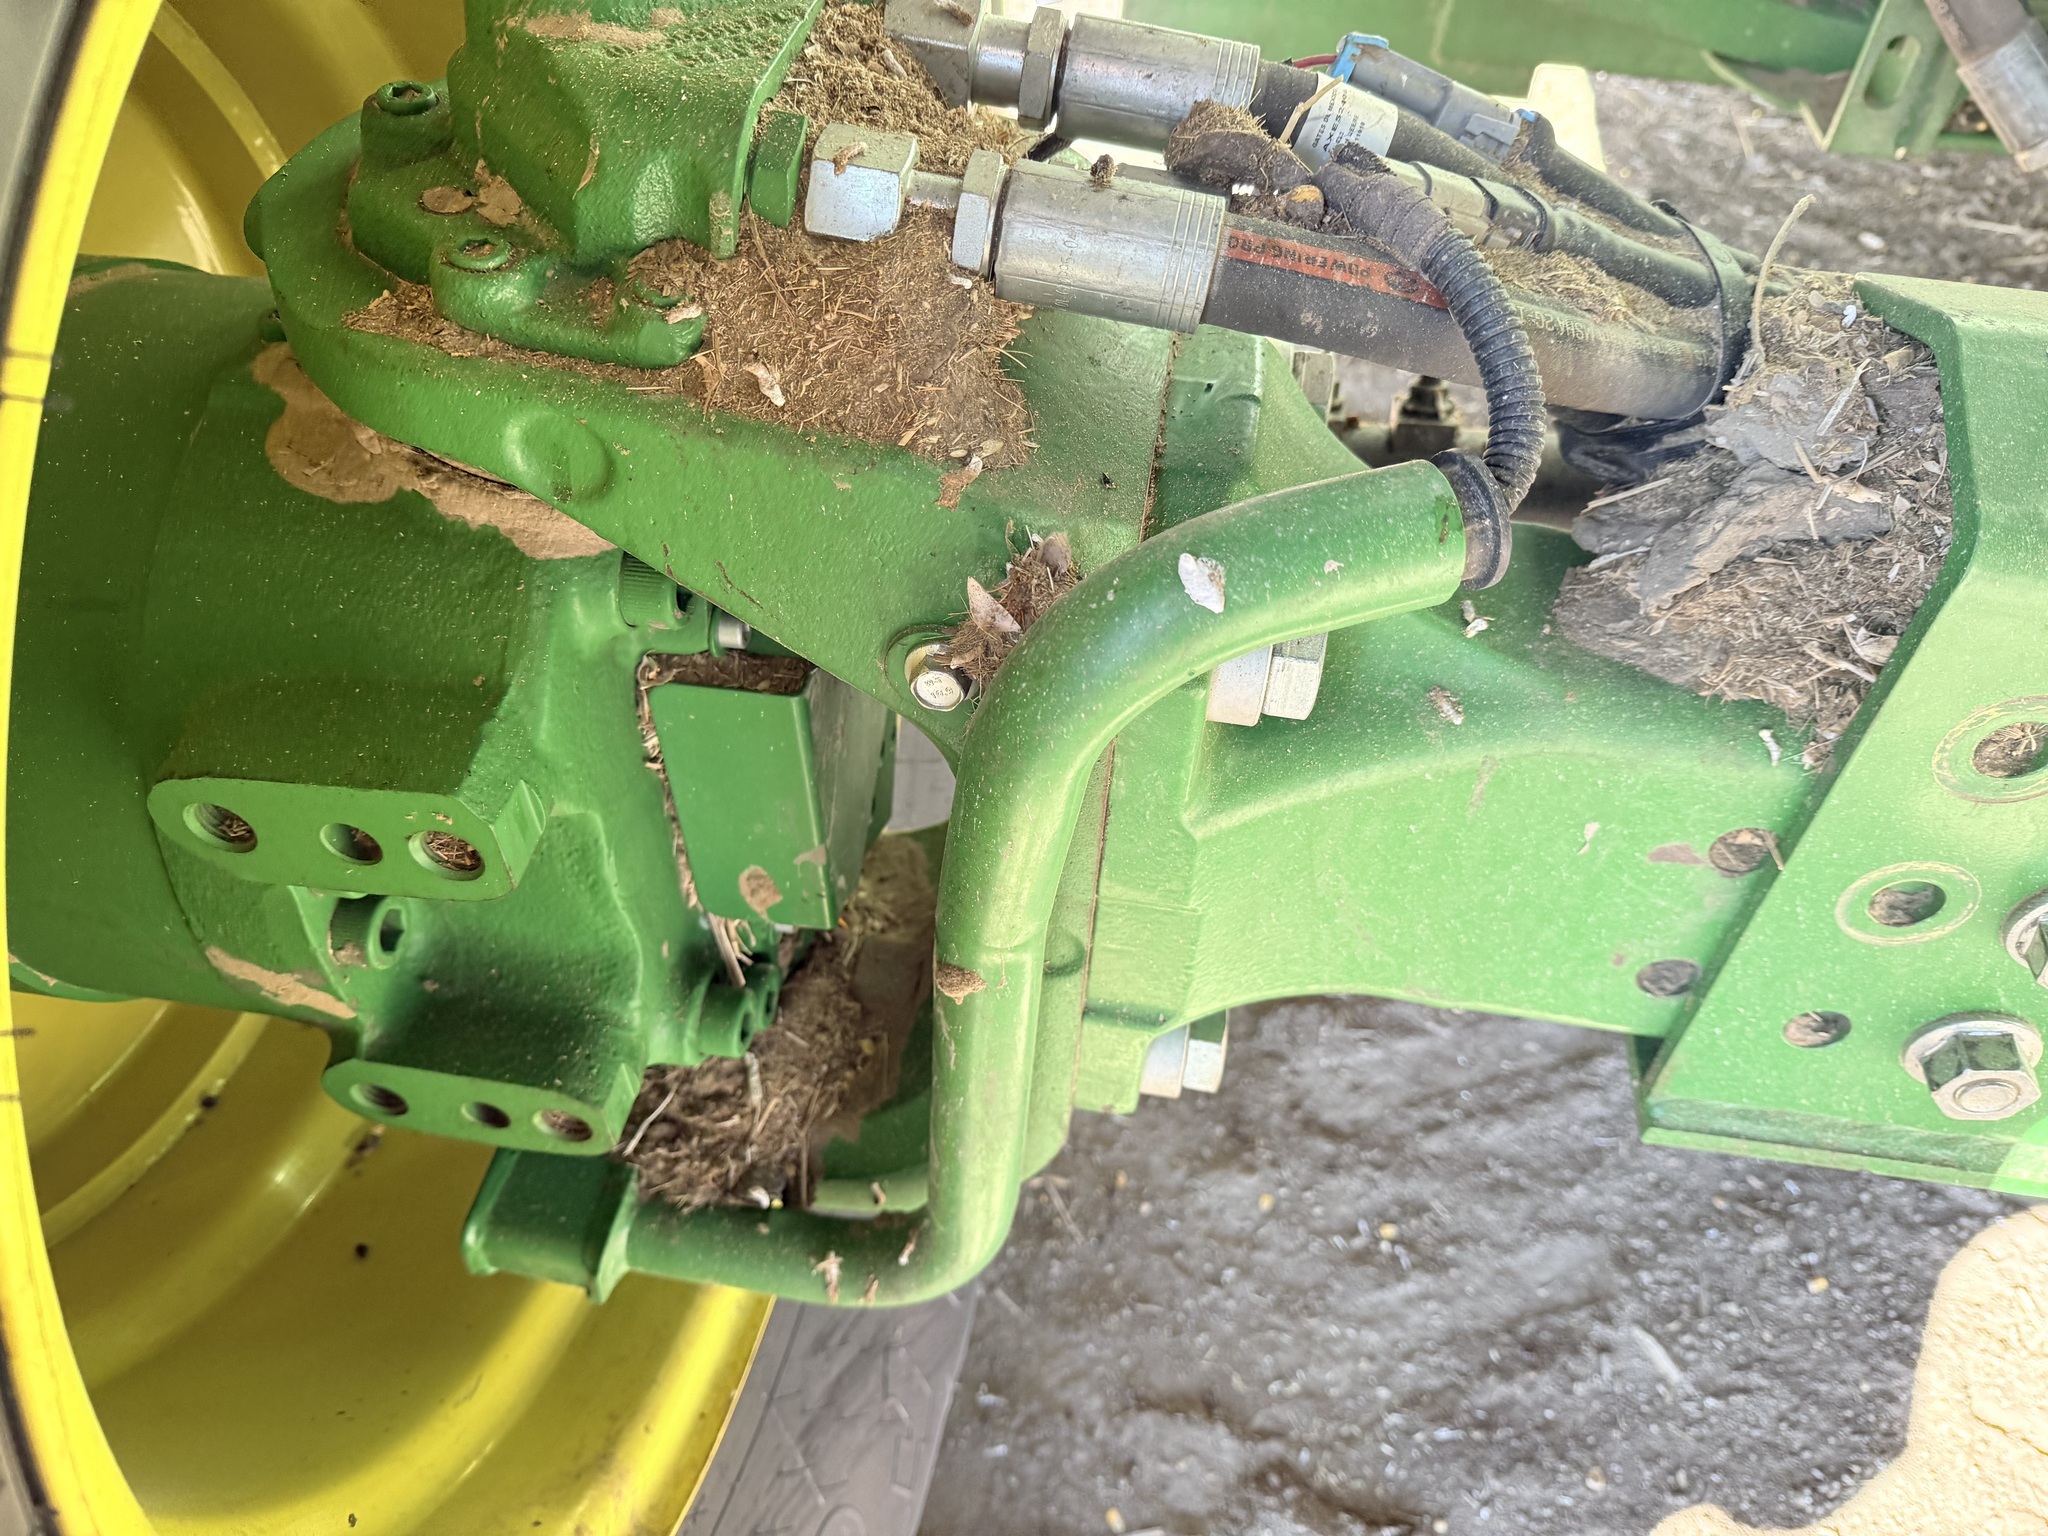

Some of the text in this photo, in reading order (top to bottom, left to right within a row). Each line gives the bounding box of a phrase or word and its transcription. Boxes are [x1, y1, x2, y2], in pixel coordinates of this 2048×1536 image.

[1311, 124, 1326, 148] GATES
[1347, 114, 1359, 137] DEERE
[1271, 245, 1372, 279] POWERING
